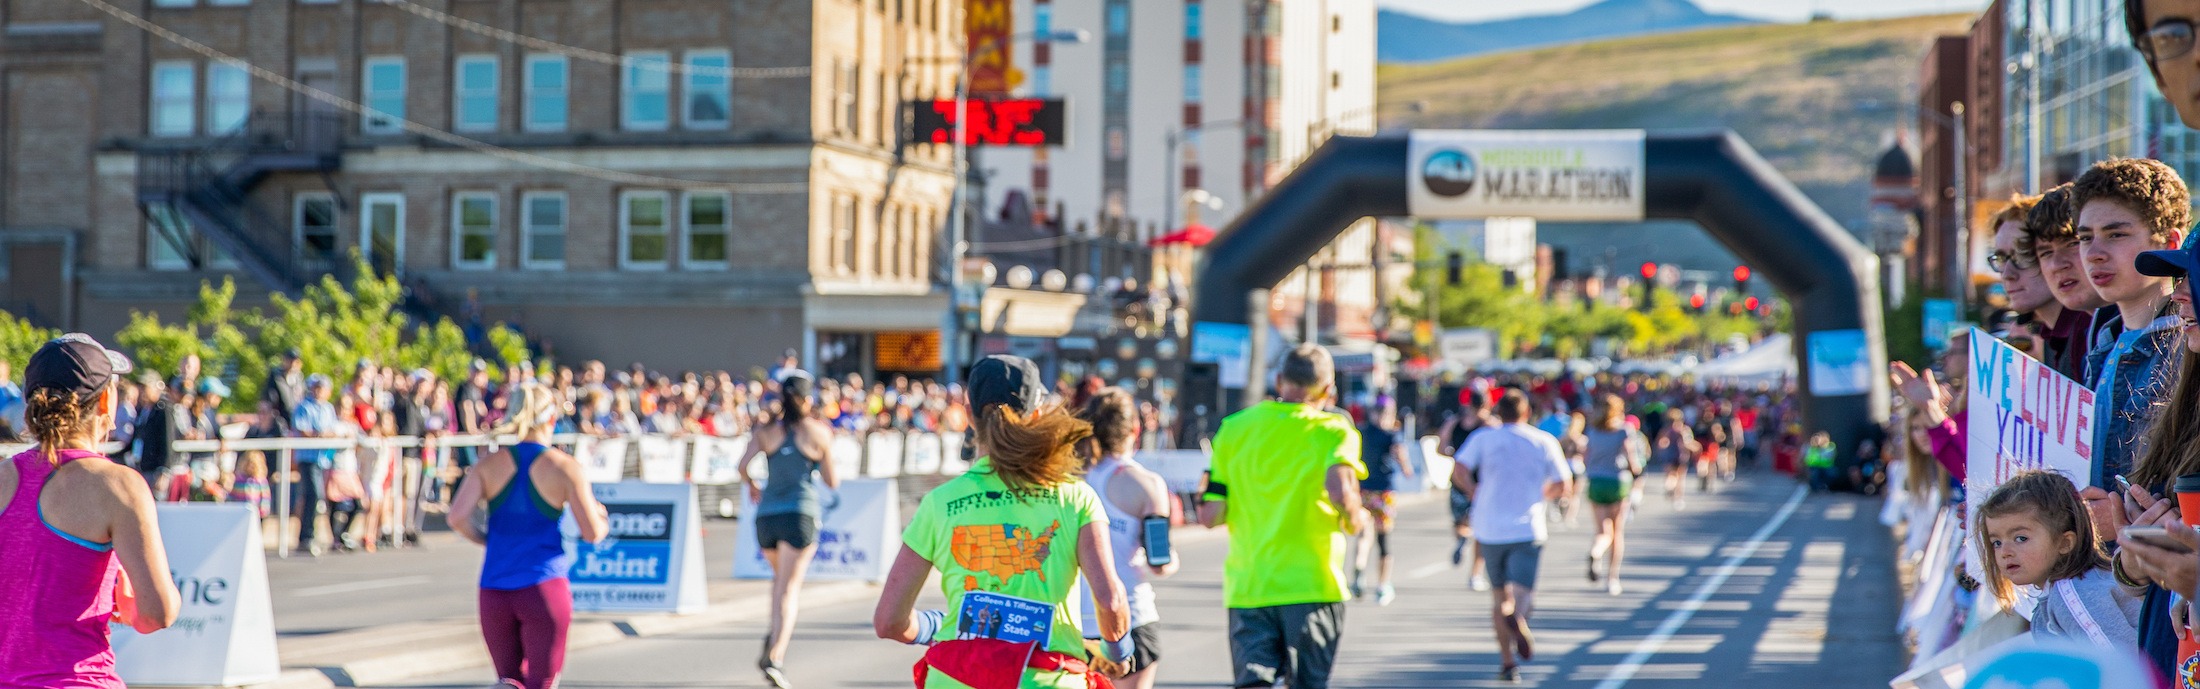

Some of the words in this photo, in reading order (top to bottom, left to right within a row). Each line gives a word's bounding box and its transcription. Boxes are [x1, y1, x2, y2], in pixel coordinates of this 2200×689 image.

[1483, 167, 1632, 200] MARATHON
[1970, 326, 2013, 413] WE
[2021, 355, 2094, 461] LOVE
[946, 492, 983, 513] FIFTY
[1005, 487, 1058, 500] STATES
[608, 512, 668, 537] one
[577, 551, 659, 579] Joint
[973, 595, 1004, 606] Colleen
[1005, 599, 1012, 608] &
[1013, 601, 1046, 615] Tiffany's
[1003, 623, 1031, 637] State
[1007, 613, 1029, 625] 50th
